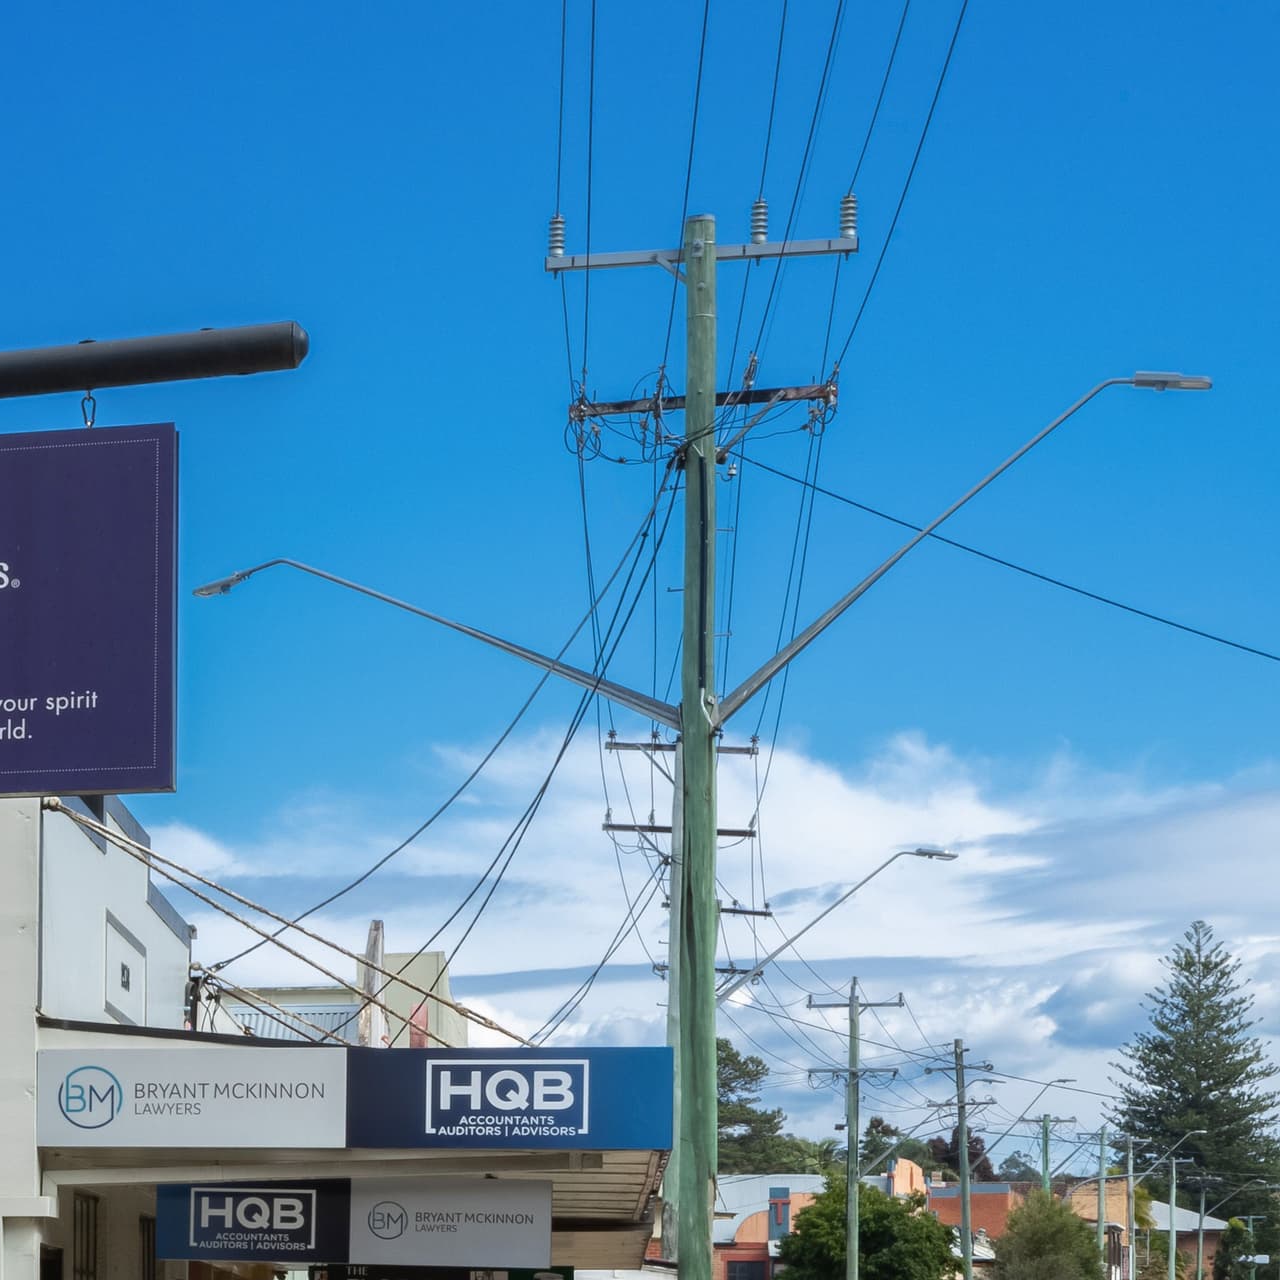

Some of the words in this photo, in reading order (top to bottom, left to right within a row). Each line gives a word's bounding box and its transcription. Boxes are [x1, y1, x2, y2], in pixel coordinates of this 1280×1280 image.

[45, 690, 98, 716] spirit
[134, 1082, 210, 1099] BRYANT
[213, 1082, 325, 1099] MCKINNON
[440, 1069, 575, 1111] HQB
[62, 1072, 119, 1122] BM
[134, 1102, 201, 1115] LAWYERS
[458, 1115, 555, 1125] ACCOUNTANTS
[438, 1126, 501, 1136] AUDITORS
[511, 1126, 576, 1136] ADVISORS
[200, 1196, 305, 1230] HQB
[415, 1211, 463, 1223] BRYANT
[464, 1212, 534, 1225] MCKINNON
[415, 1224, 457, 1233] LAWYERS
[216, 1232, 289, 1241] ACCOUNTANTS
[199, 1241, 248, 1249] AUDITORS
[256, 1242, 306, 1250] ADVISORS
[346, 1265, 368, 1276] THE
